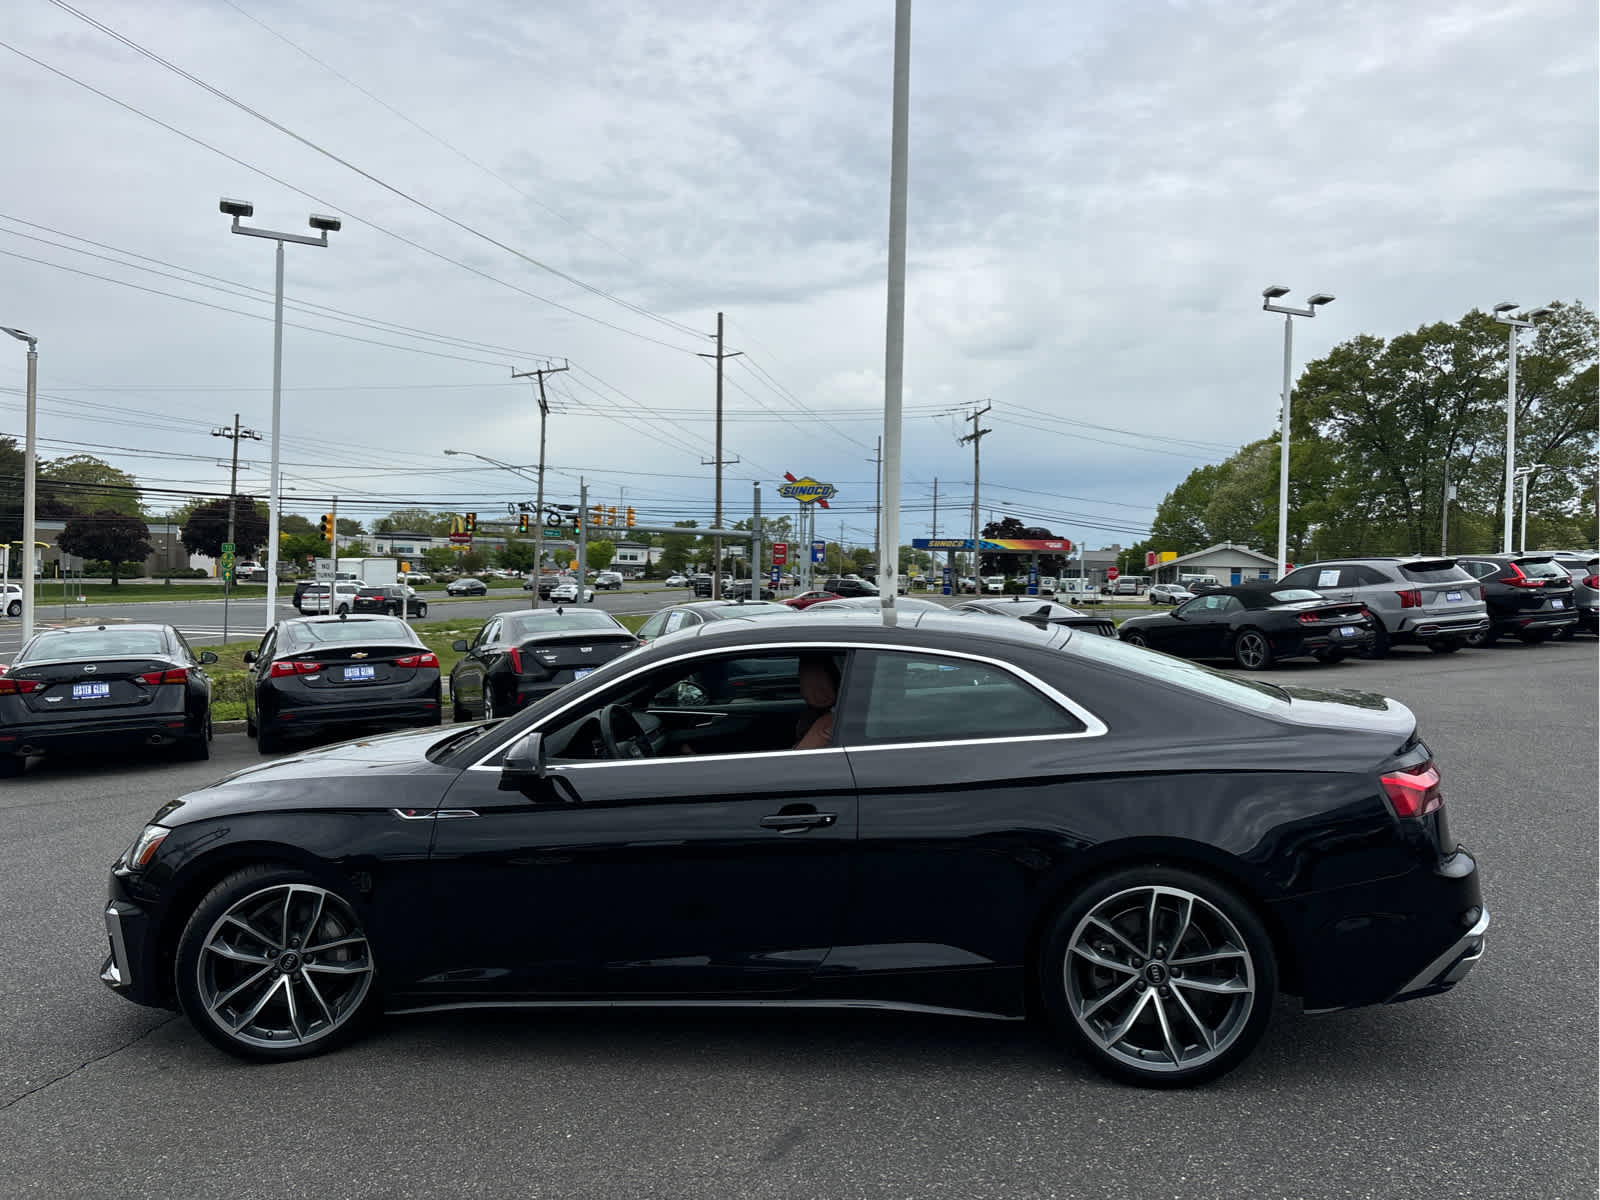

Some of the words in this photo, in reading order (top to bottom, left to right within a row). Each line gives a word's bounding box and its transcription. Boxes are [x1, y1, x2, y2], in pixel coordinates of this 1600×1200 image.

[783, 485, 831, 496] SUNOCO
[928, 540, 965, 548] SUNOCO
[73, 684, 92, 697] LESTER
[93, 682, 110, 695] GLENN
